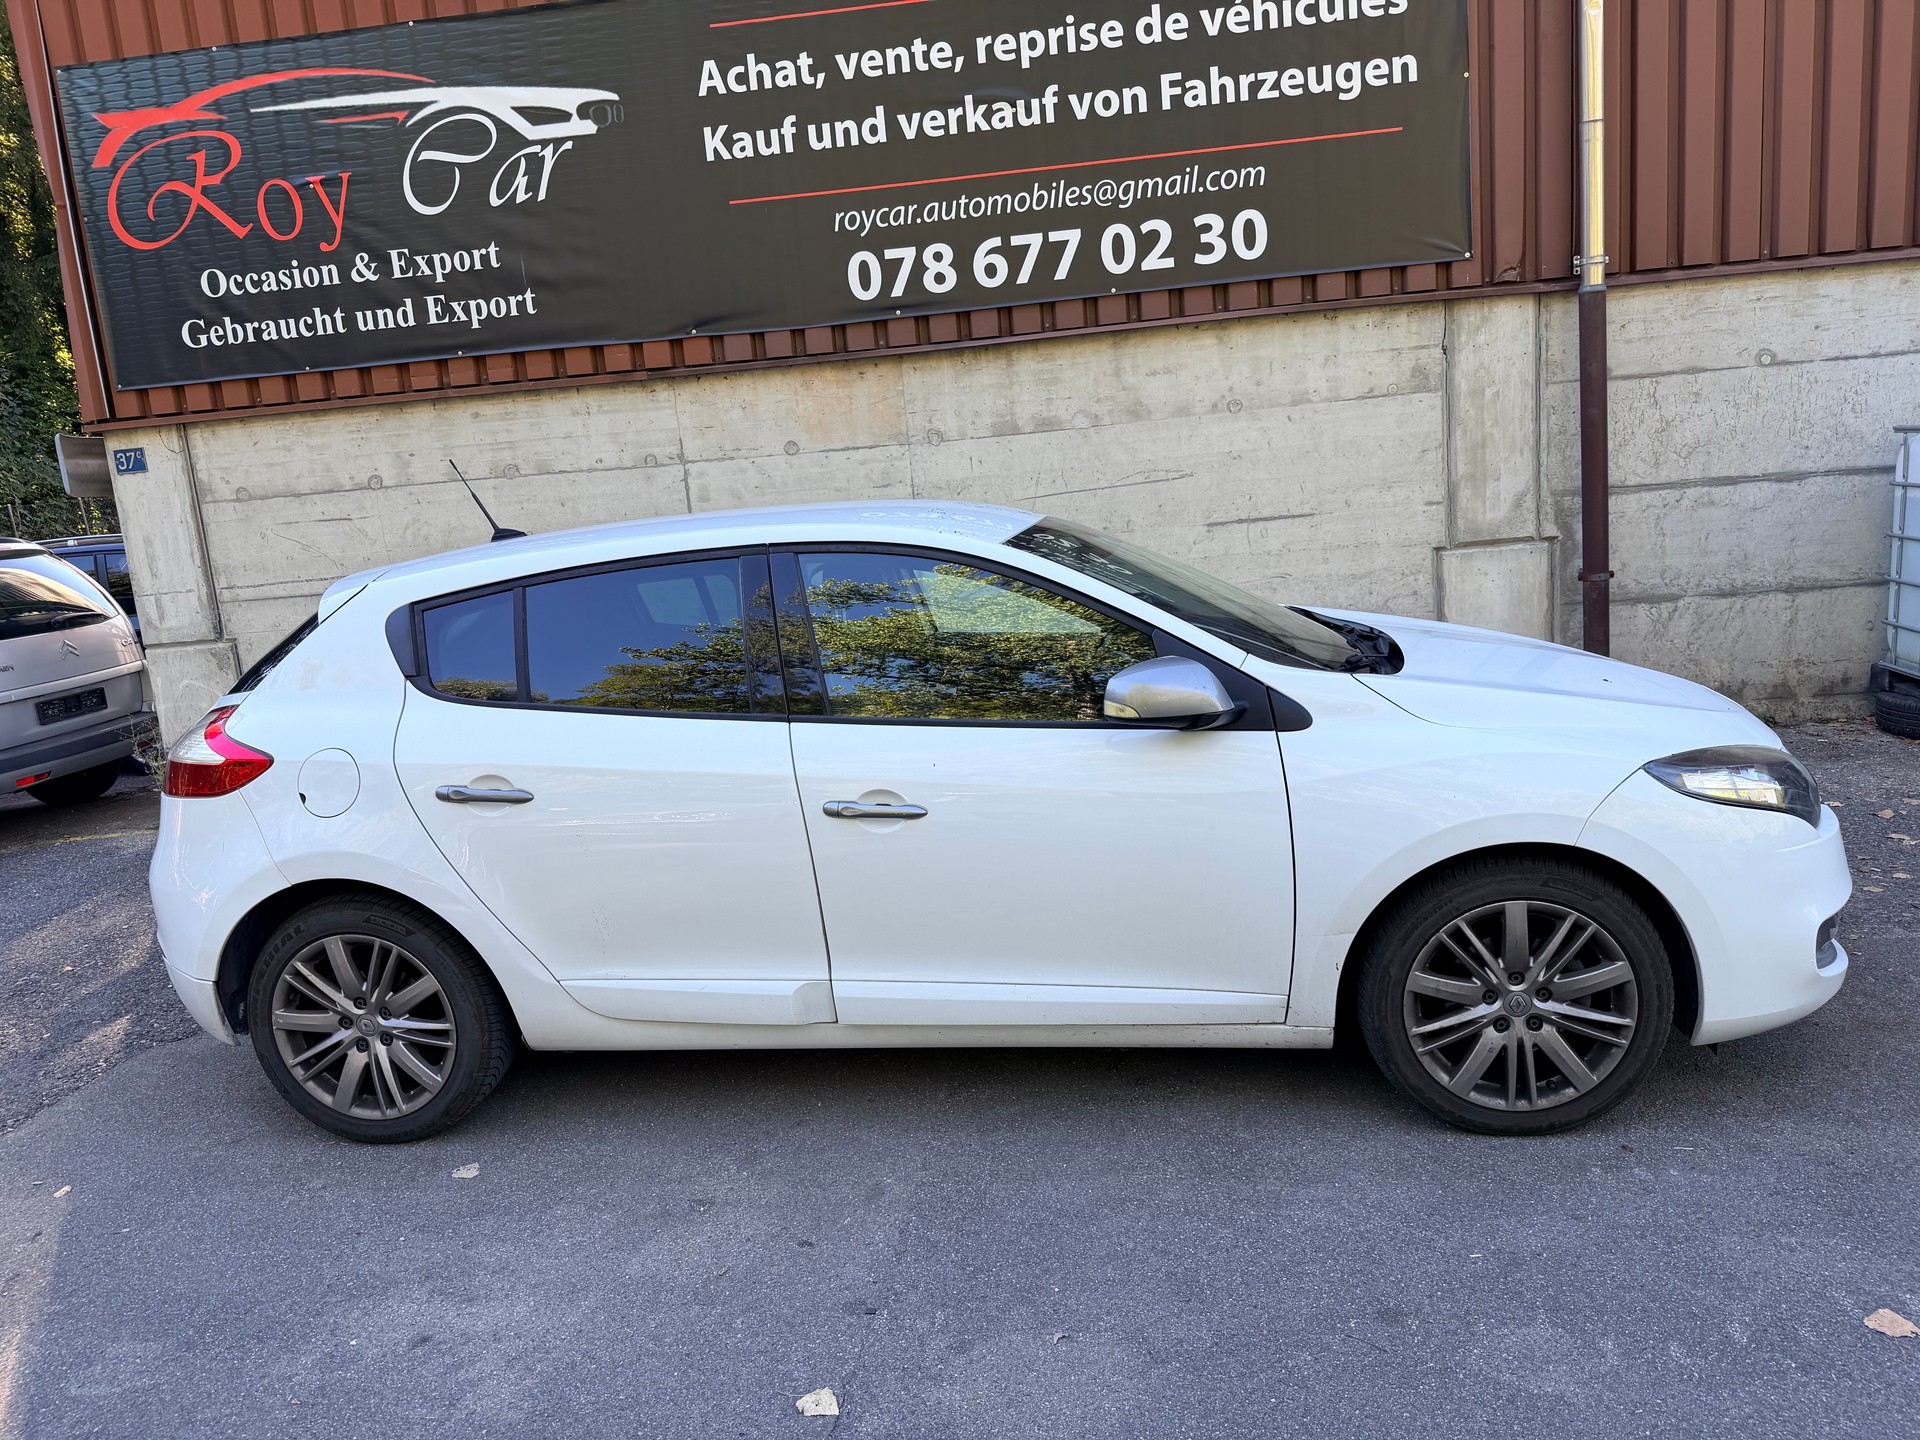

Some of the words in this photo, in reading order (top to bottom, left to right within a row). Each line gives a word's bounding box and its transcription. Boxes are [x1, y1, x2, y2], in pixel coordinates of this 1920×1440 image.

[699, 52, 826, 97] Achat,
[834, 38, 965, 80] vente,
[976, 15, 1124, 69] reprise
[1135, 4, 1189, 45] de
[702, 115, 797, 162] Kauf
[807, 105, 888, 151] und
[896, 84, 1059, 140] verkauf
[1068, 86, 1148, 121] von
[1160, 54, 1418, 111] Fahrzeugen
[108, 130, 352, 252] Roy
[402, 113, 574, 216] Car
[834, 164, 1266, 239] roycar.automobiles@gmail.com
[200, 258, 342, 299] Occasion
[350, 252, 380, 283] &
[388, 240, 502, 284] Export
[847, 243, 958, 301] 078
[972, 229, 1082, 288] 677
[1100, 219, 1175, 275] 02
[1192, 208, 1268, 265] 30
[181, 306, 348, 349] Gebraucht
[354, 297, 417, 332] und
[423, 287, 538, 329] Export
